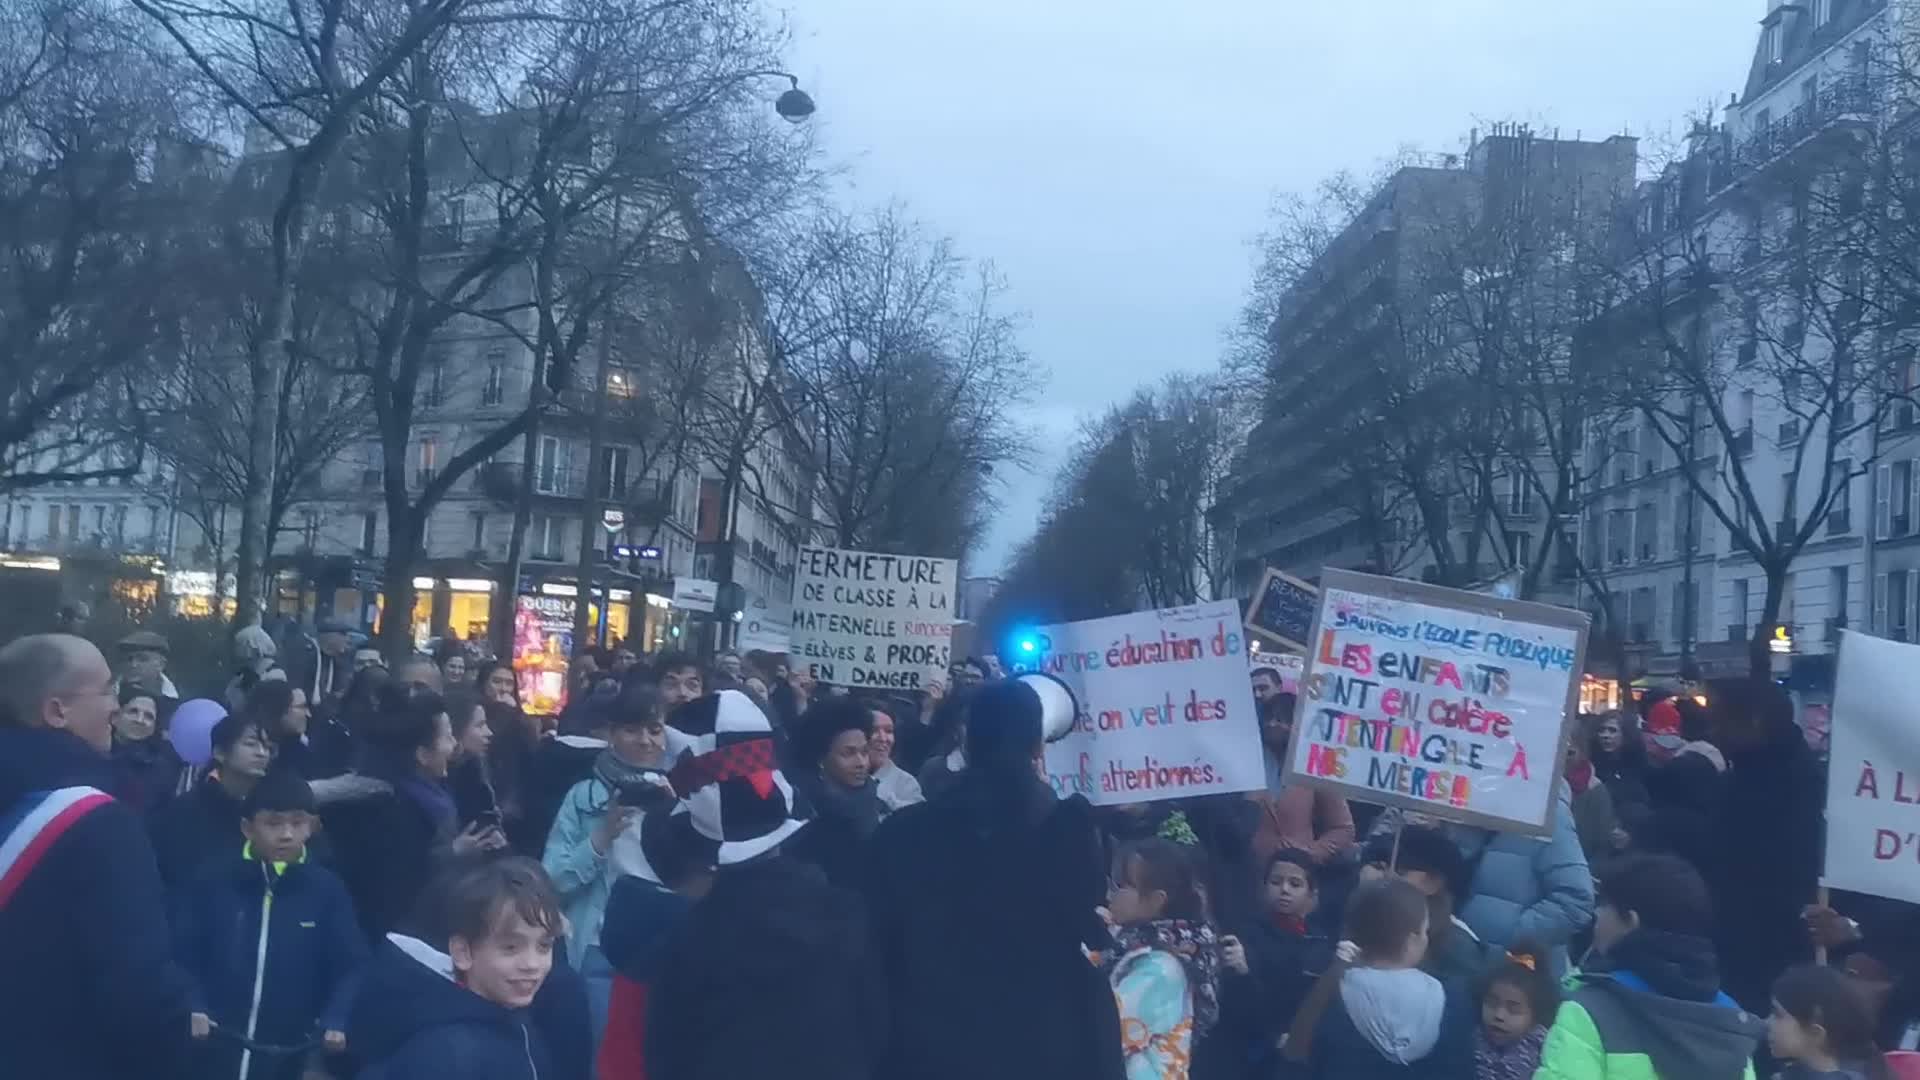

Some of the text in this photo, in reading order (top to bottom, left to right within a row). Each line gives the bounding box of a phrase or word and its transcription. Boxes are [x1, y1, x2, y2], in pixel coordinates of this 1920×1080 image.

[800, 548, 944, 585] FERMETURE
[803, 583, 947, 609] DE CLASSE À LA
[791, 610, 897, 638] MATERNELLE
[863, 645, 876, 664] &
[1105, 631, 1202, 668] éducation
[1211, 620, 1241, 658] de
[1318, 627, 1373, 677] LES
[809, 662, 920, 689] EN DANGER
[1099, 708, 1124, 732] on
[1129, 692, 1176, 728] veut
[1184, 688, 1227, 722] des
[1505, 741, 1529, 781] À
[1855, 760, 1879, 800] À
[1873, 828, 1920, 867] D'
